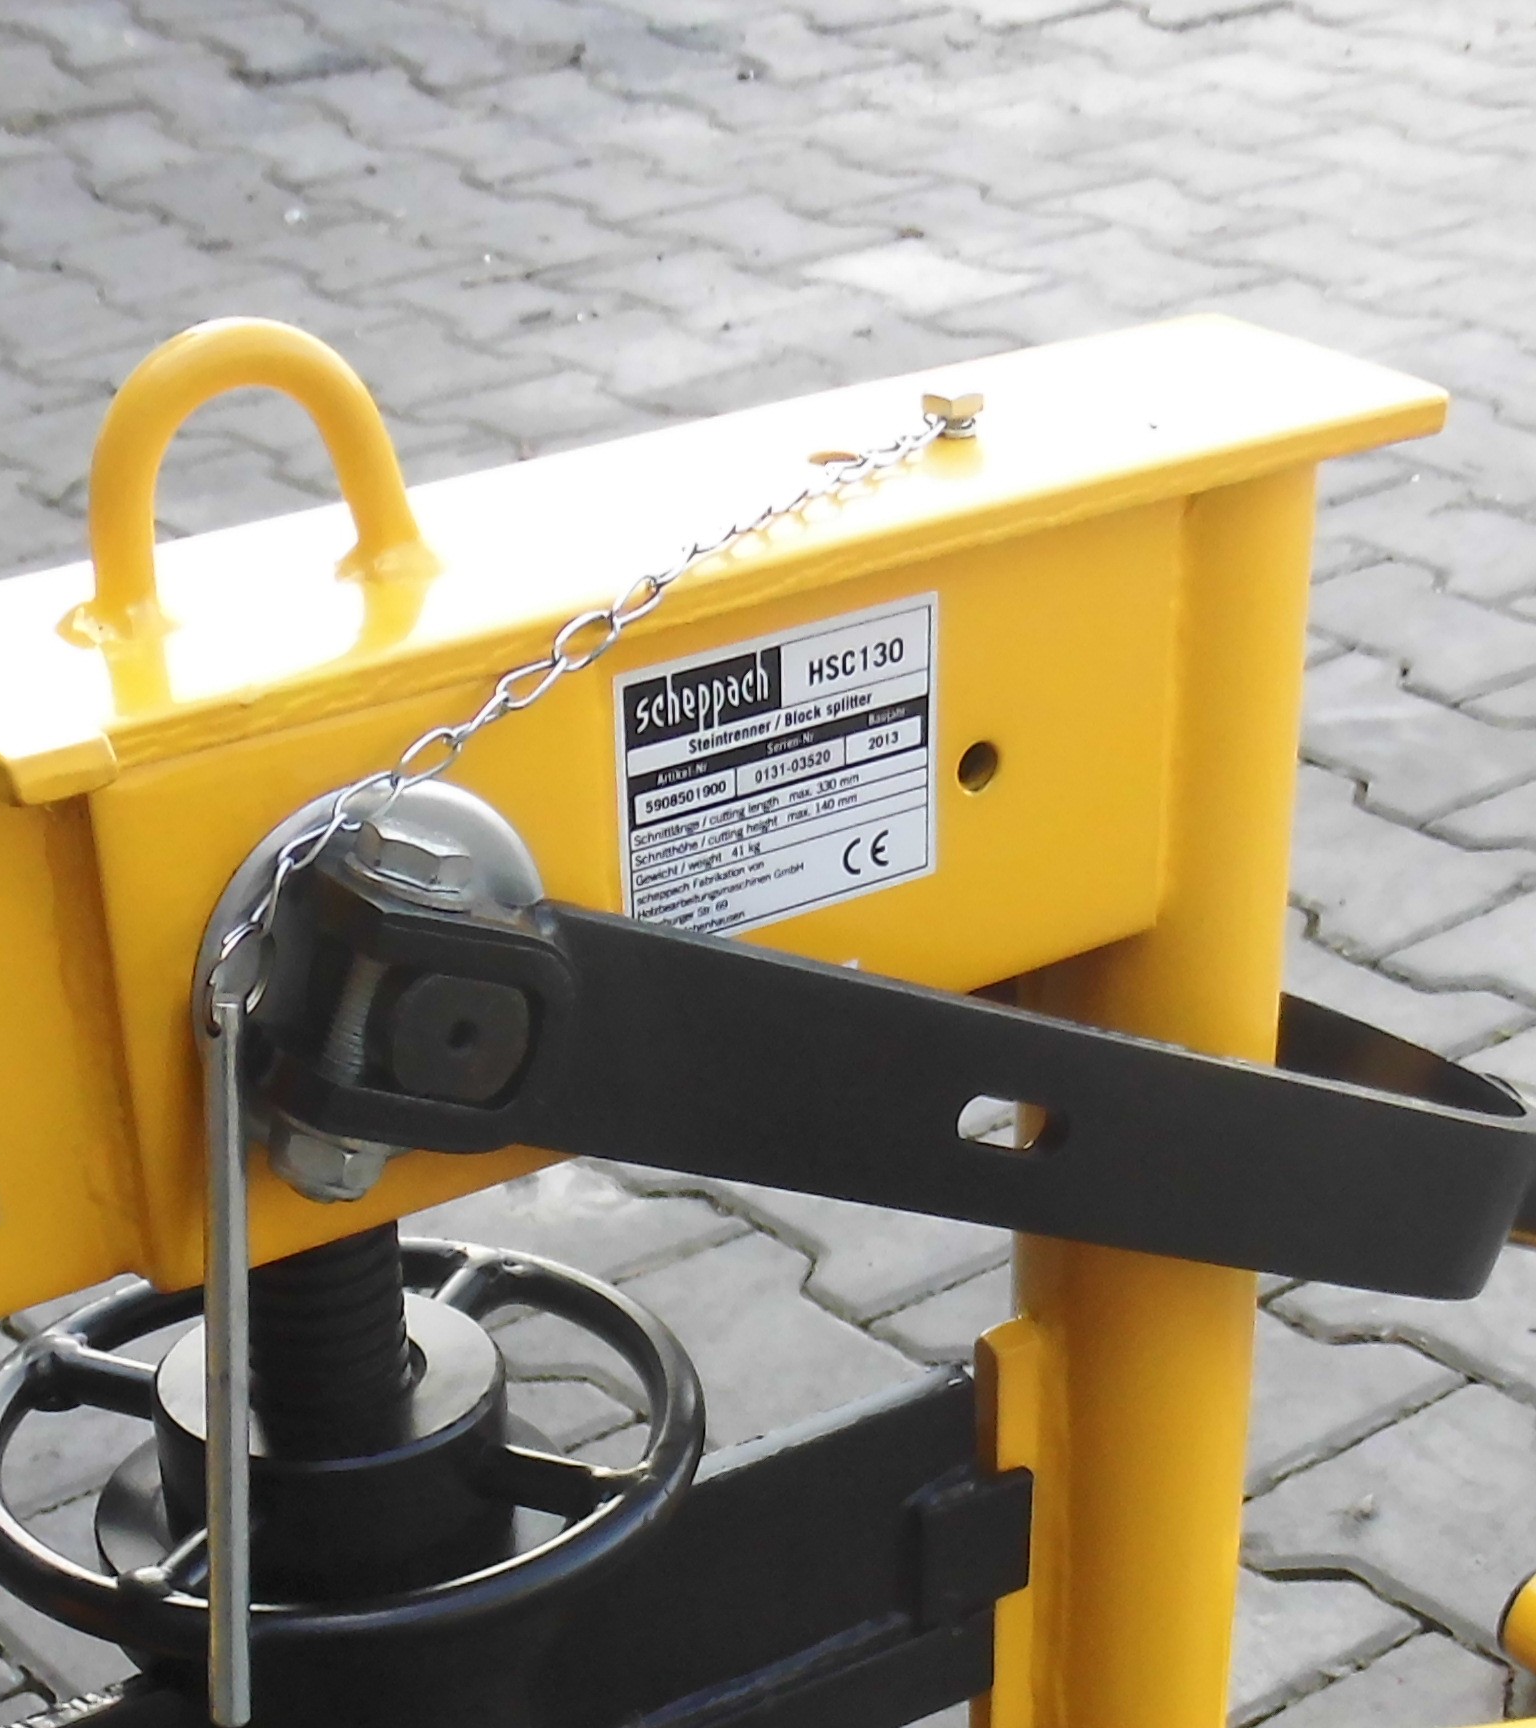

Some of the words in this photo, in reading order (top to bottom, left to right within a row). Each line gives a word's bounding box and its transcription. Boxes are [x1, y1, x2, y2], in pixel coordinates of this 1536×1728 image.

[808, 637, 904, 686] HSC130
[635, 651, 769, 734] scheppach
[868, 707, 906, 727] Baujahr
[688, 723, 771, 754] Steintrenner
[775, 714, 782, 731] /
[784, 706, 821, 728] Block
[826, 693, 873, 721] splitter
[645, 780, 726, 814] 5908501900
[755, 750, 831, 784] 0131-03520
[868, 731, 900, 750] 2013
[634, 821, 700, 847] Schnittlänge
[702, 816, 707, 827] /
[709, 808, 745, 825] cutting
[748, 796, 779, 813] length
[789, 789, 812, 802] max.
[816, 779, 836, 795] 330
[840, 773, 859, 787] mm
[635, 841, 699, 867] Schnitthöhe
[701, 836, 706, 847] /
[708, 827, 743, 845] cutting
[746, 815, 778, 833] height
[787, 809, 811, 822] max.
[816, 798, 835, 814] 140
[838, 794, 858, 808] mm
[636, 866, 678, 886] Gewicht
[680, 862, 686, 876] /
[688, 853, 722, 870] weight
[732, 845, 744, 858] 41
[748, 842, 761, 855] kg
[636, 883, 690, 905] scheppach
[693, 866, 745, 889] Fabrikation
[748, 861, 765, 873] von
[774, 862, 804, 878] GmbH
